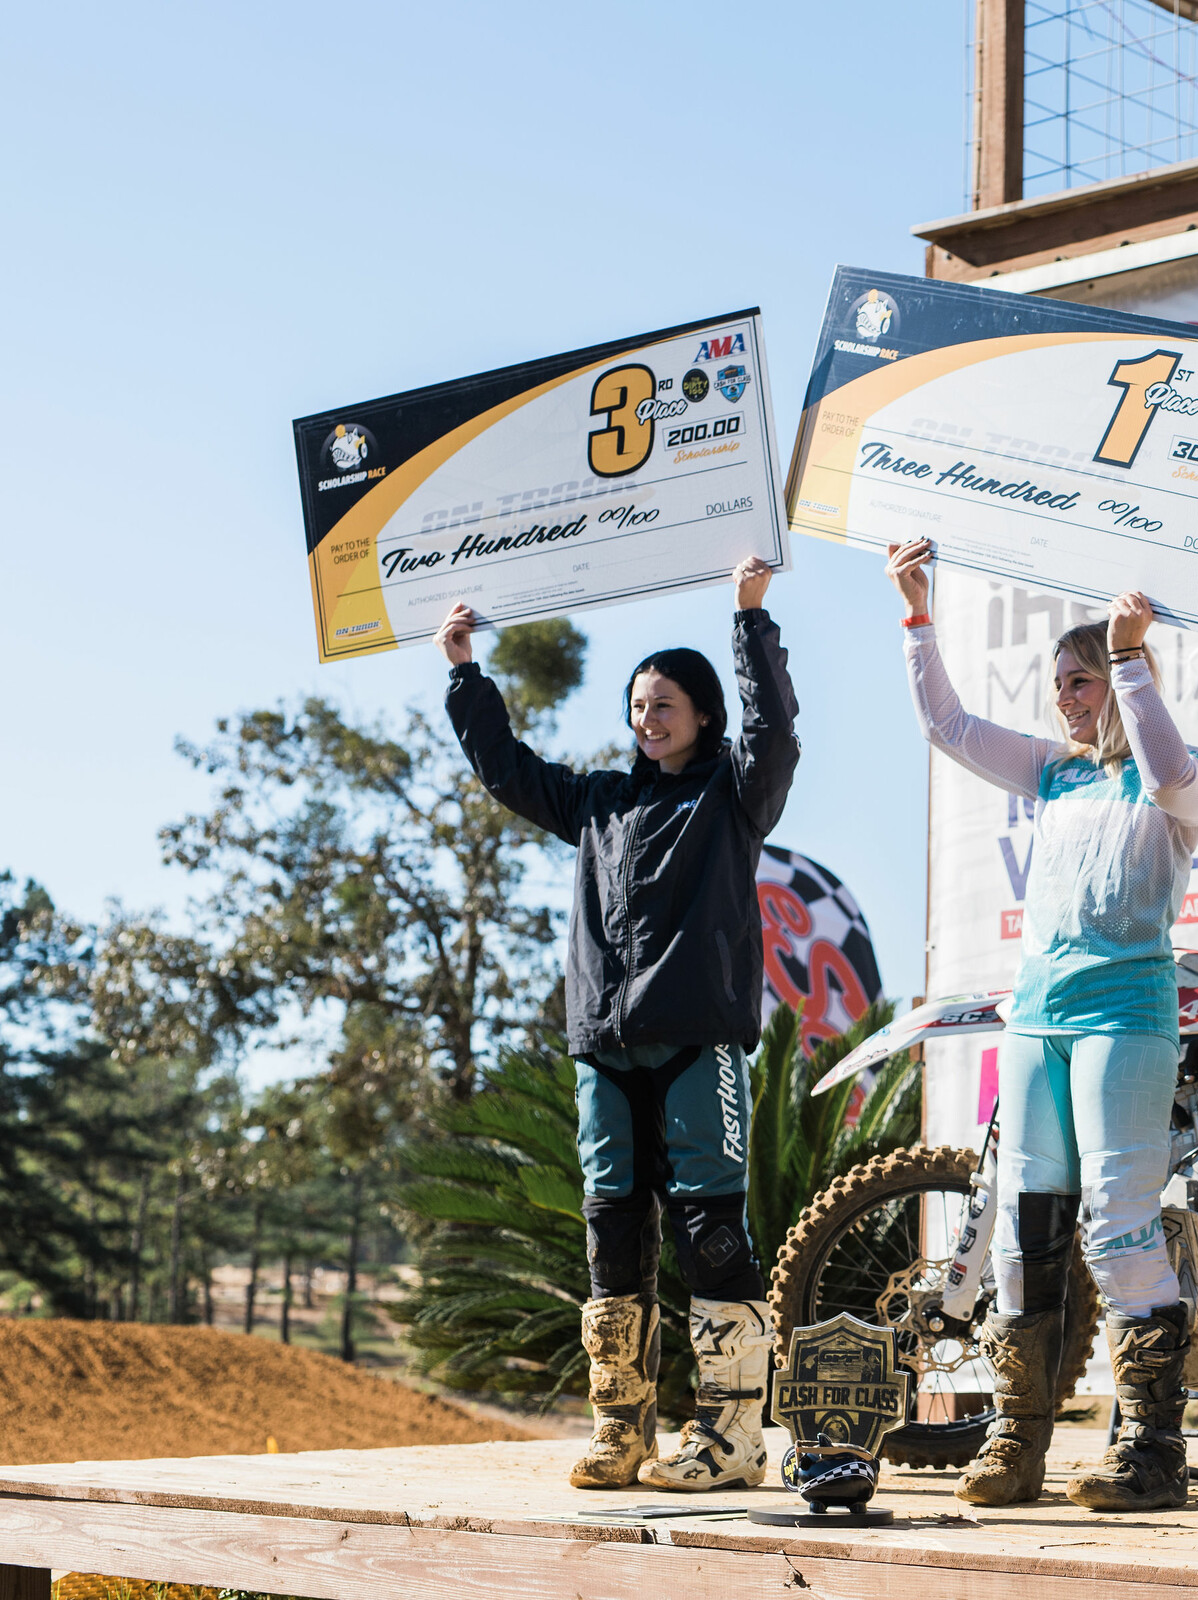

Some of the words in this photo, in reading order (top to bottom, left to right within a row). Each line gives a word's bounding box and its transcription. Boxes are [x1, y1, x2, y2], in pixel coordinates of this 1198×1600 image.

[693, 333, 747, 363] AMA
[879, 348, 899, 360] RACE
[587, 363, 657, 478] 3
[658, 377, 673, 391] RD
[634, 398, 689, 426] Place
[822, 411, 836, 421] PAY
[836, 413, 845, 423] TO
[846, 415, 859, 426] THE
[1093, 348, 1183, 469] 1
[1175, 369, 1194, 382] ST
[667, 416, 740, 448] 200.00
[821, 423, 844, 436] ORDER
[845, 428, 855, 437] OF
[673, 440, 741, 464] Scholarship
[318, 471, 368, 491] SCHOLARSHIP
[367, 466, 386, 479] RACE
[860, 442, 933, 478] Three
[936, 461, 1081, 511] Hundred
[704, 495, 753, 517] DOLLARS
[331, 544, 344, 554] PAY
[345, 541, 355, 551] TO
[356, 538, 370, 548] THE
[381, 548, 445, 579] Two
[452, 514, 587, 564] Hundred
[1030, 536, 1049, 548] DATE
[333, 551, 359, 565] ORDER
[360, 549, 370, 558] OF
[572, 563, 591, 572] DATE
[408, 589, 447, 607] AUTHORIZED
[449, 584, 483, 600] SIGNATURE
[823, 1385, 850, 1406] FOR
[855, 1387, 898, 1412] CLASS
